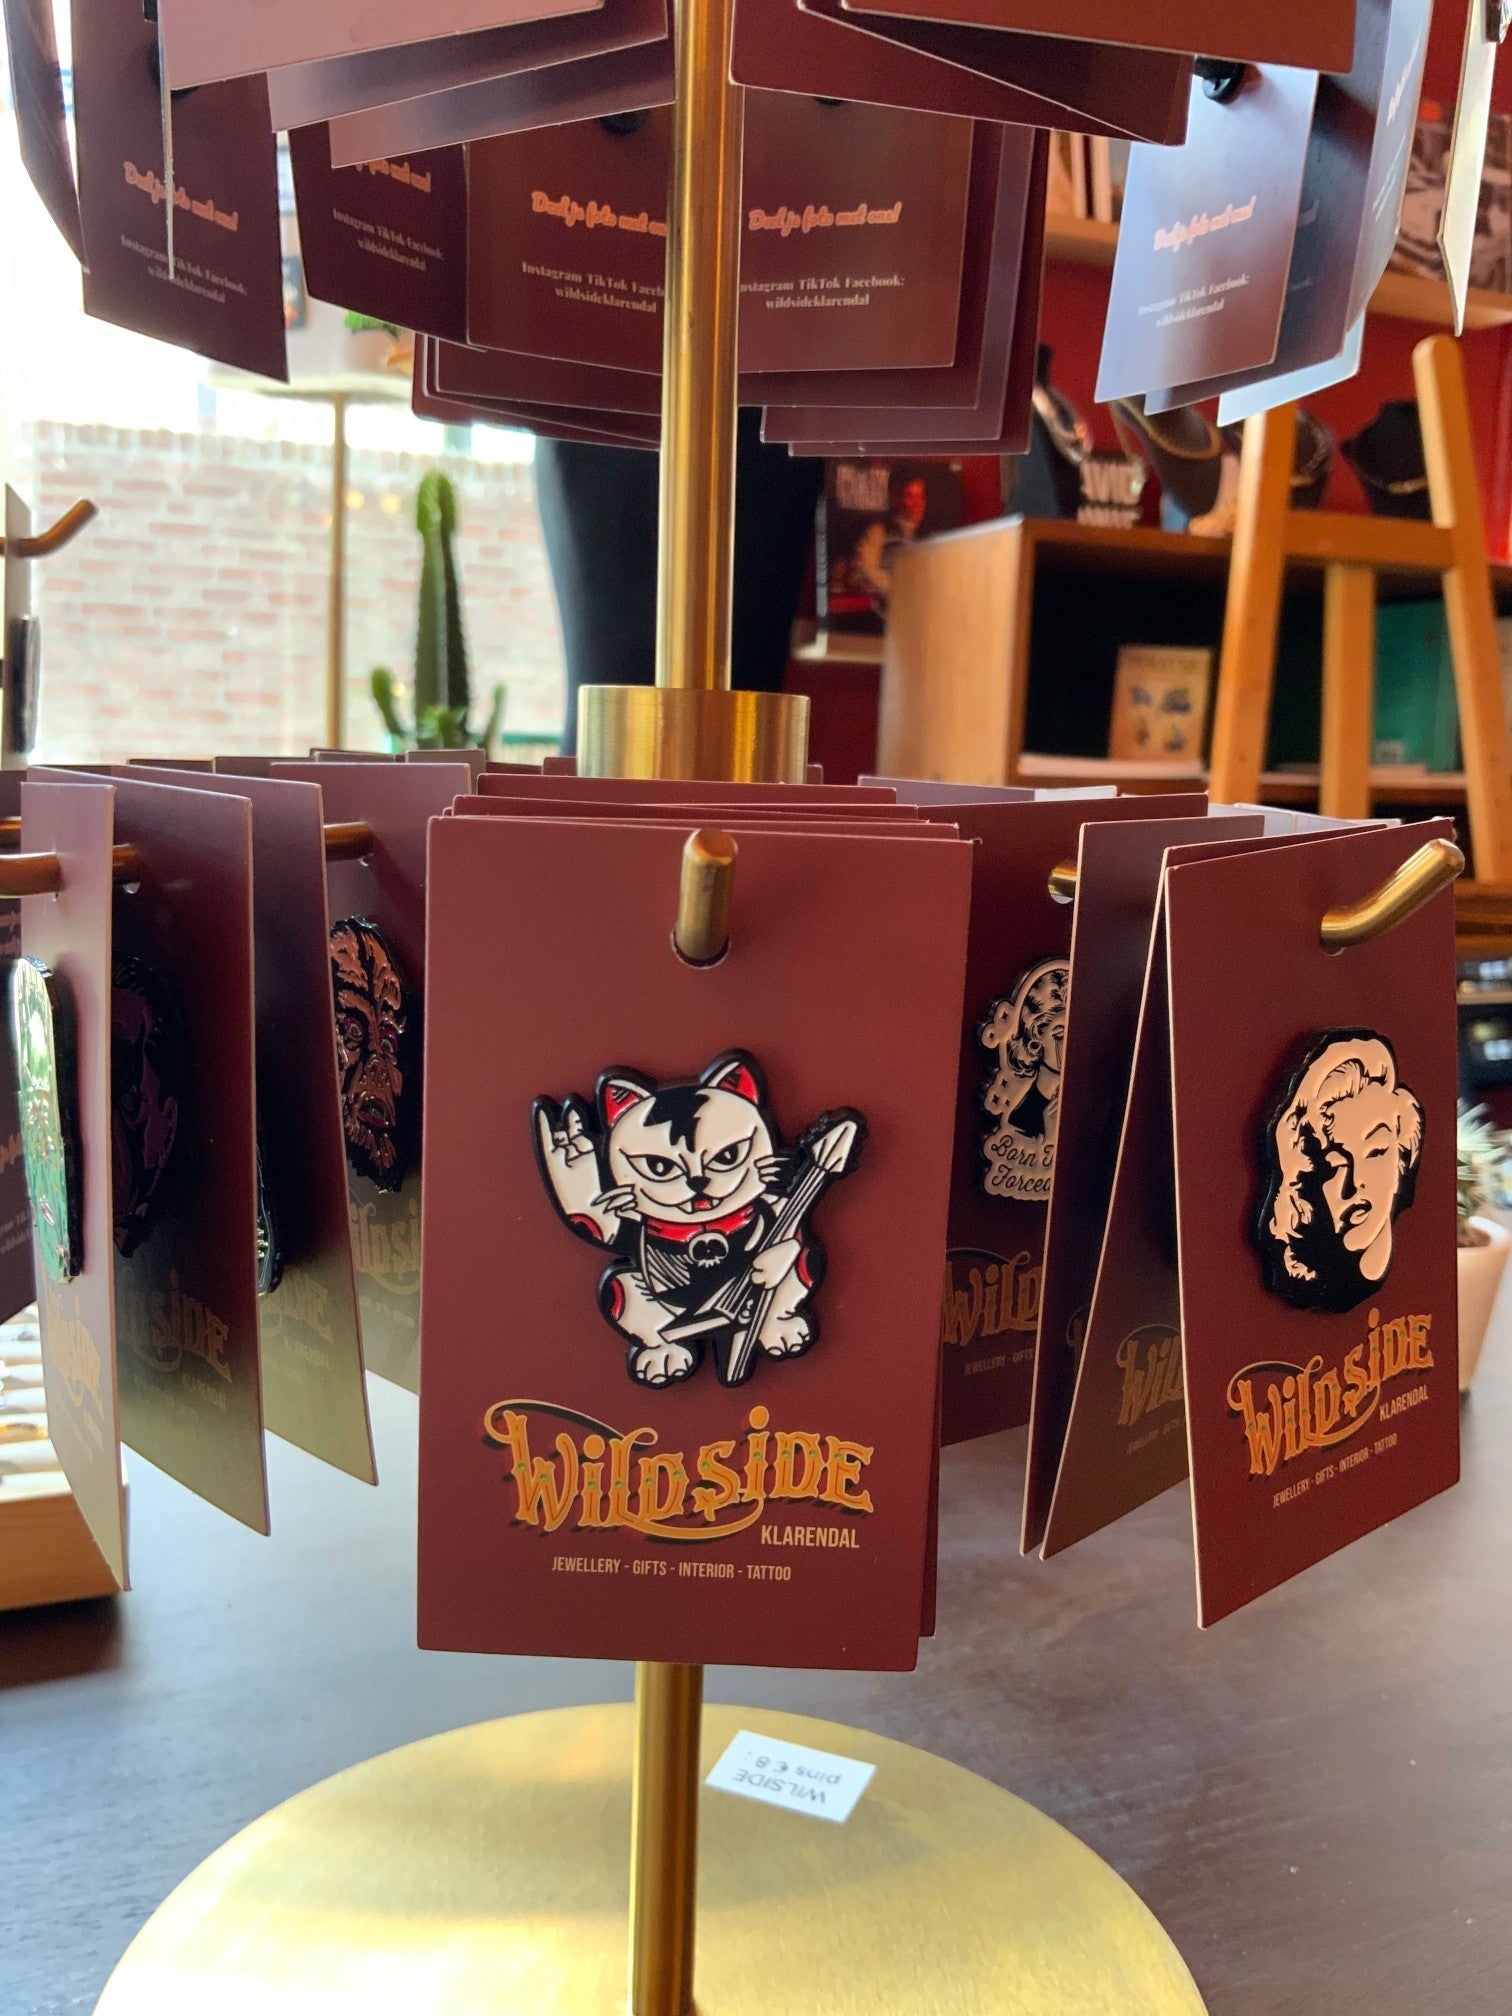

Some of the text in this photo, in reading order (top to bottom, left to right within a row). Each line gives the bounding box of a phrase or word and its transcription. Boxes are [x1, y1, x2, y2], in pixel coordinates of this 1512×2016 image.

[739, 281, 794, 293] nstagram
[991, 1134, 1038, 1167] Born
[1379, 1384, 1429, 1422] KLARENDAL
[1273, 1478, 1310, 1508] JEWELLERY
[1315, 1464, 1334, 1485] GIFTS
[1339, 1447, 1369, 1473] INTERIOR
[1374, 1432, 1398, 1456] TATTOO
[761, 1525, 860, 1549] KLARENDAL
[551, 1556, 621, 1575] JEWELLERY
[632, 1559, 667, 1577] GIFTS
[678, 1561, 734, 1579] INTERIOR
[746, 1564, 791, 1581] TATTOO
[796, 1766, 842, 1785] pins
